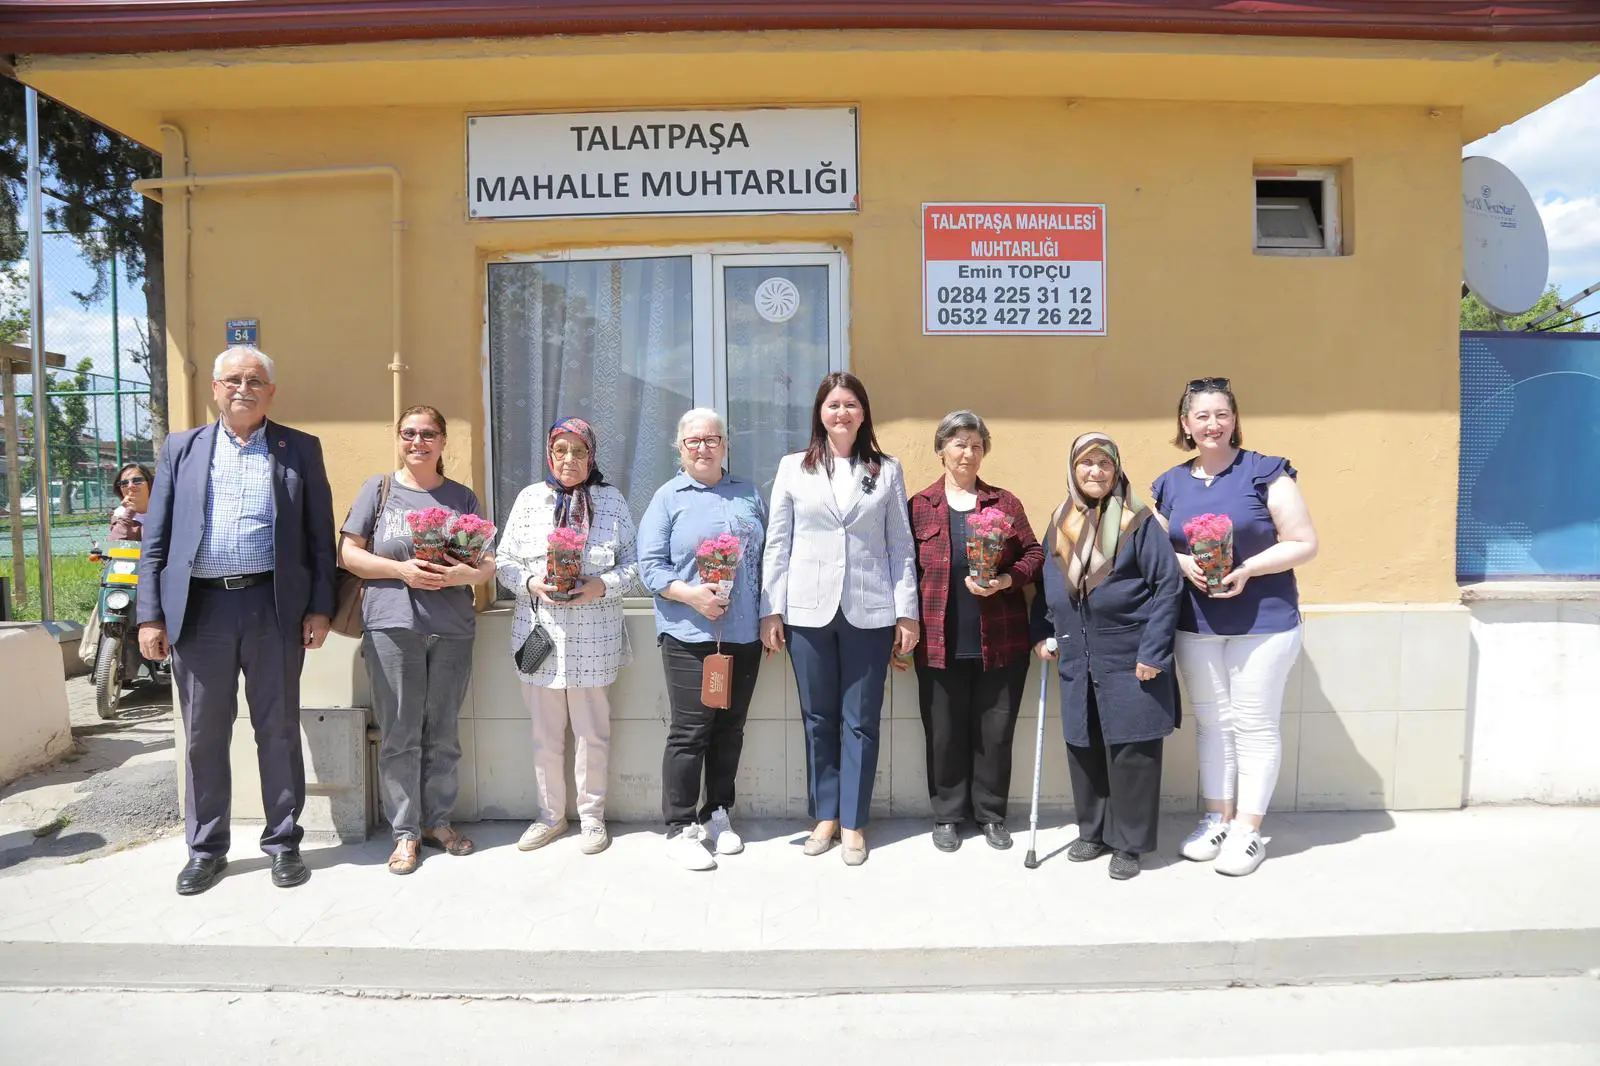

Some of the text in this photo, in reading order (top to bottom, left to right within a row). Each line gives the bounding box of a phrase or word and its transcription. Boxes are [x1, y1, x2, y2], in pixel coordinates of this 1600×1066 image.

[570, 122, 750, 155] TALATPAŞA
[476, 161, 847, 202] MAHALLE MUHTARLIĞI
[931, 210, 1096, 234] TALATPAŞA MAHALLESİ
[971, 237, 1059, 257] MUHTARLIĞI
[958, 264, 1071, 282] Emin TOPÇU
[937, 286, 1092, 304] 0284 225 31 12
[937, 307, 1092, 325] 0532 427 26 22
[235, 329, 249, 341] 54
